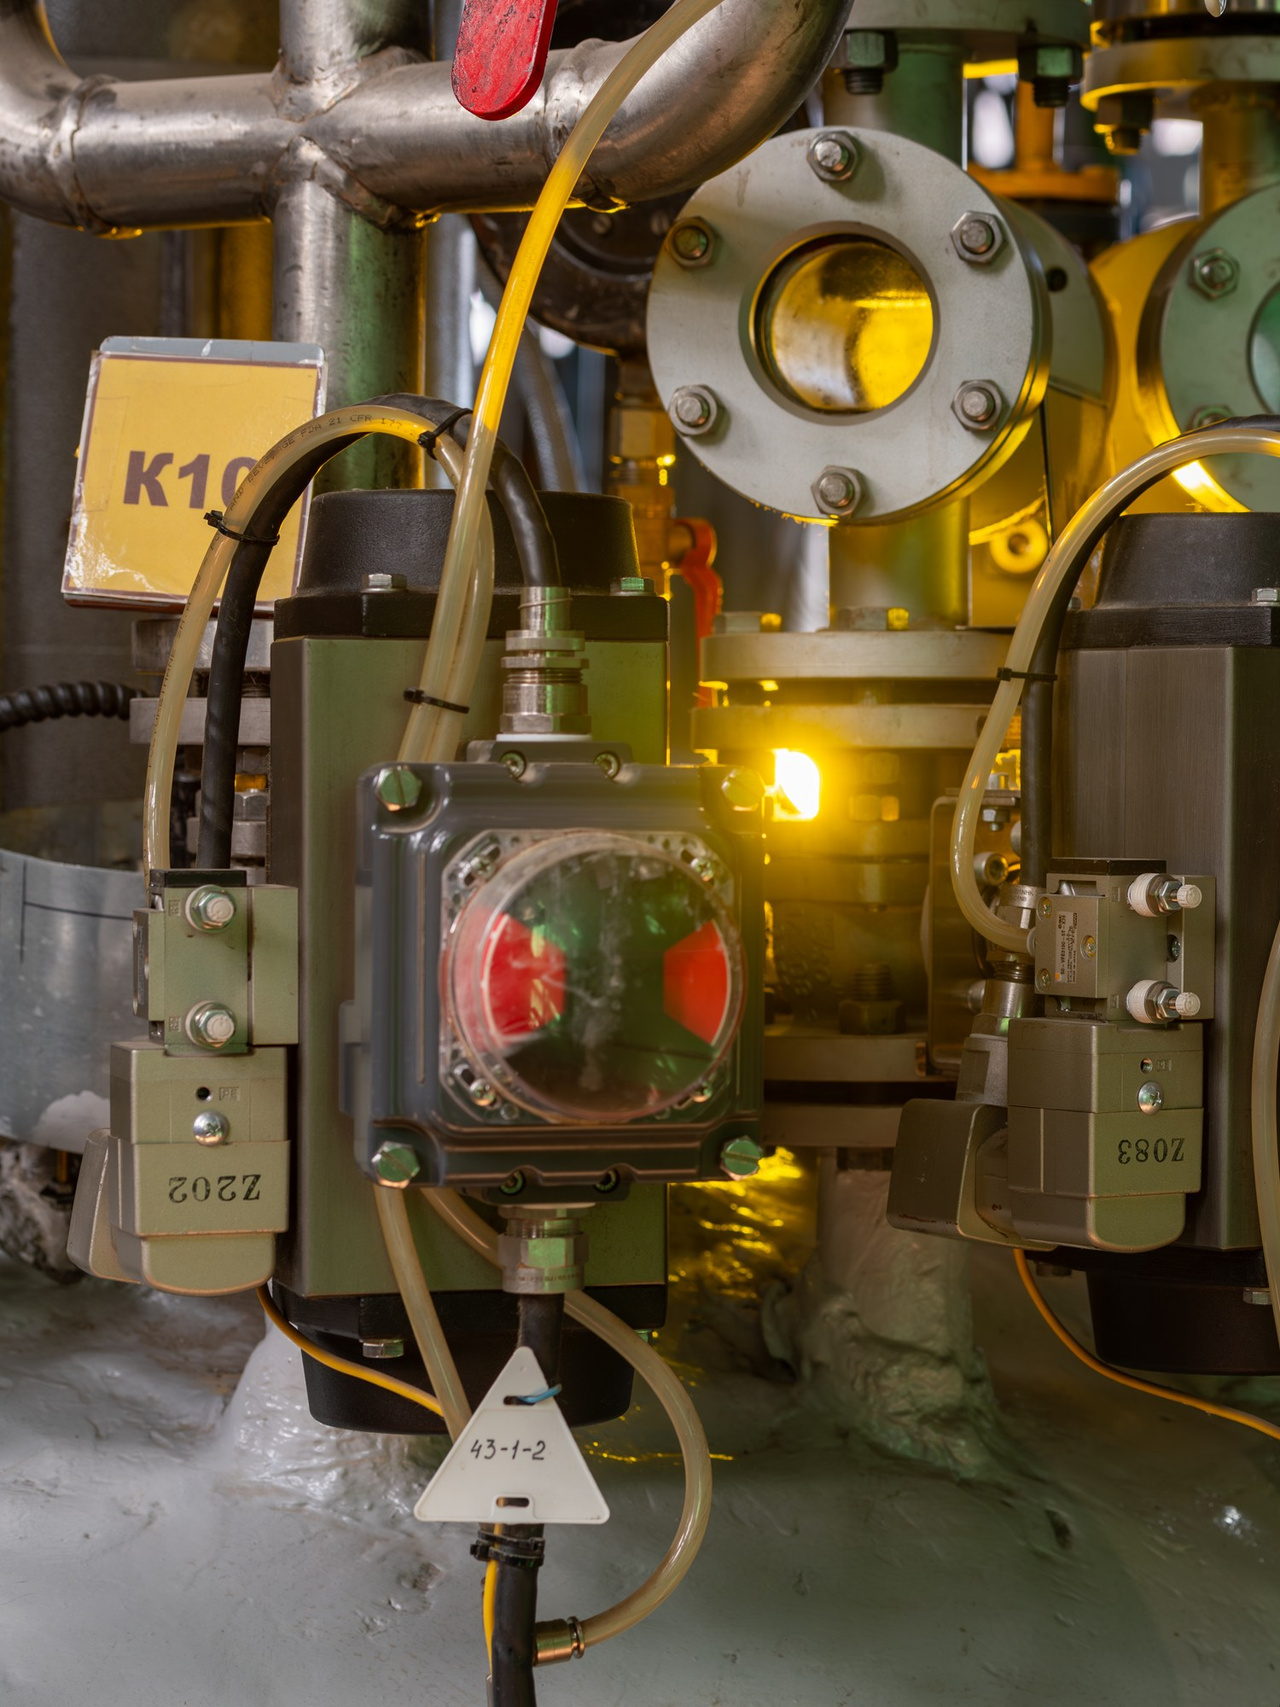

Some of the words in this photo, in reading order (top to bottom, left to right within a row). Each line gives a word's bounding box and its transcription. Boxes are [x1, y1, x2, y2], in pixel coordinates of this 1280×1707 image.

[300, 423, 322, 438] FDA
[328, 416, 342, 427] 21
[349, 413, 373, 424] CFR
[1117, 1137, 1186, 1165] Z083
[168, 1174, 262, 1204] Z202
[470, 1438, 547, 1461] 43-1-2
